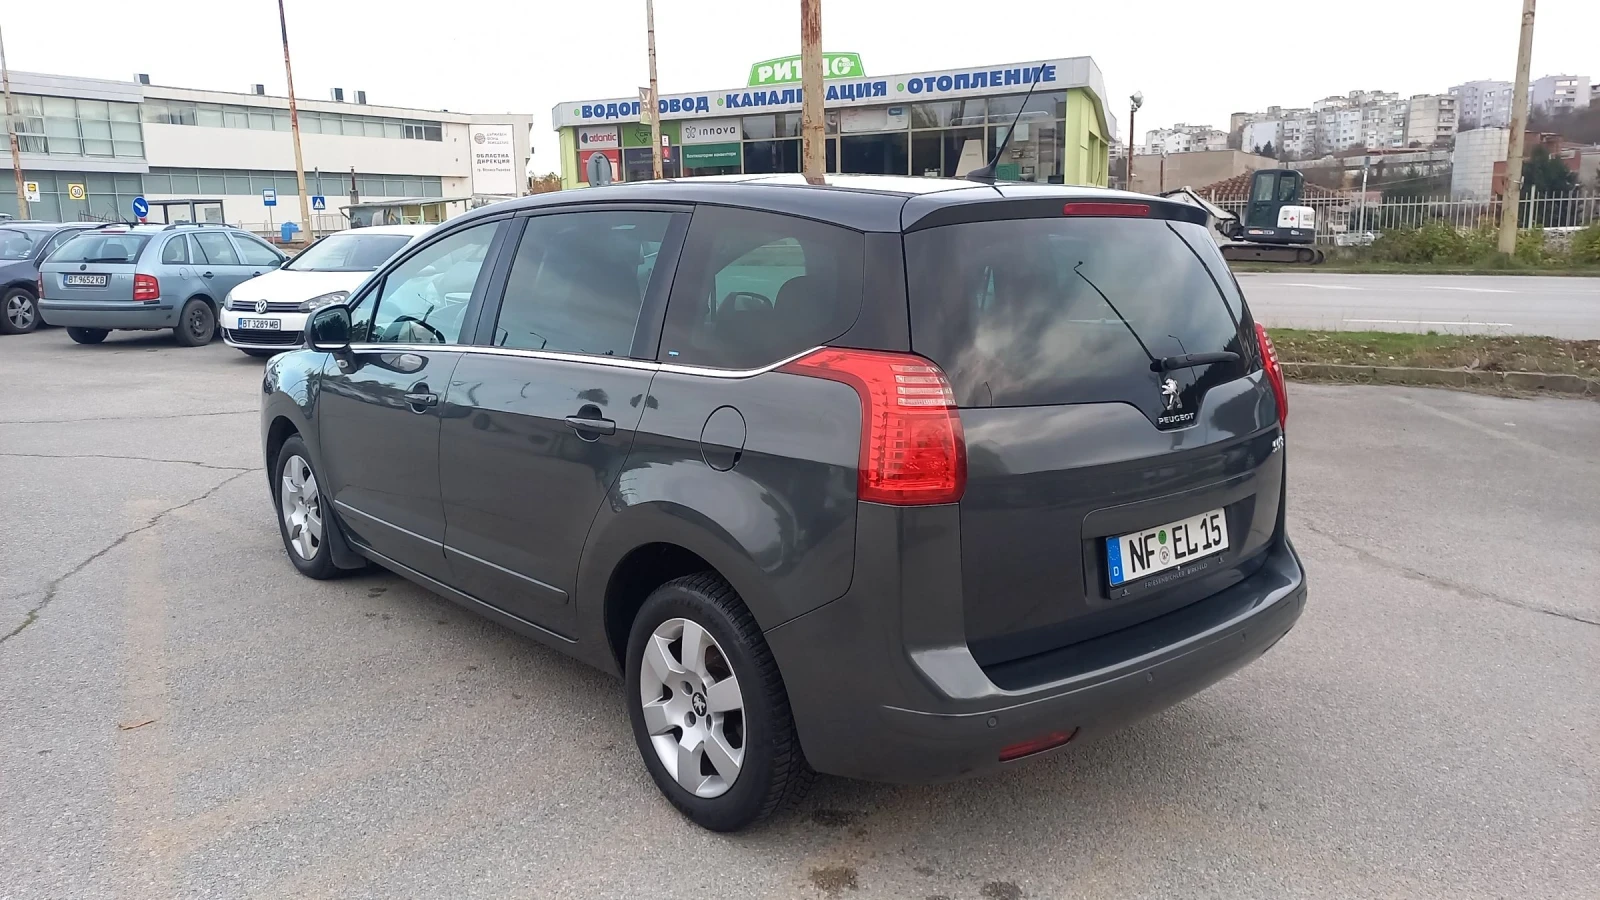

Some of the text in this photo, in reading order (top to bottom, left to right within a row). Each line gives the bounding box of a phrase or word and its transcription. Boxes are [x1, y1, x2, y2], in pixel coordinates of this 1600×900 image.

[758, 57, 851, 82] РИТО
[582, 96, 709, 119] ВОДОПОВОД
[726, 81, 886, 108] КАНАЛАЦИЯ
[907, 65, 1056, 94] ОТОПЛЕНИЕ
[589, 132, 616, 142] atlantic
[699, 126, 736, 136] innova
[252, 320, 268, 328] 3289
[1158, 412, 1194, 424] PEUGEOT
[1129, 514, 1222, 573] NF EL 15
